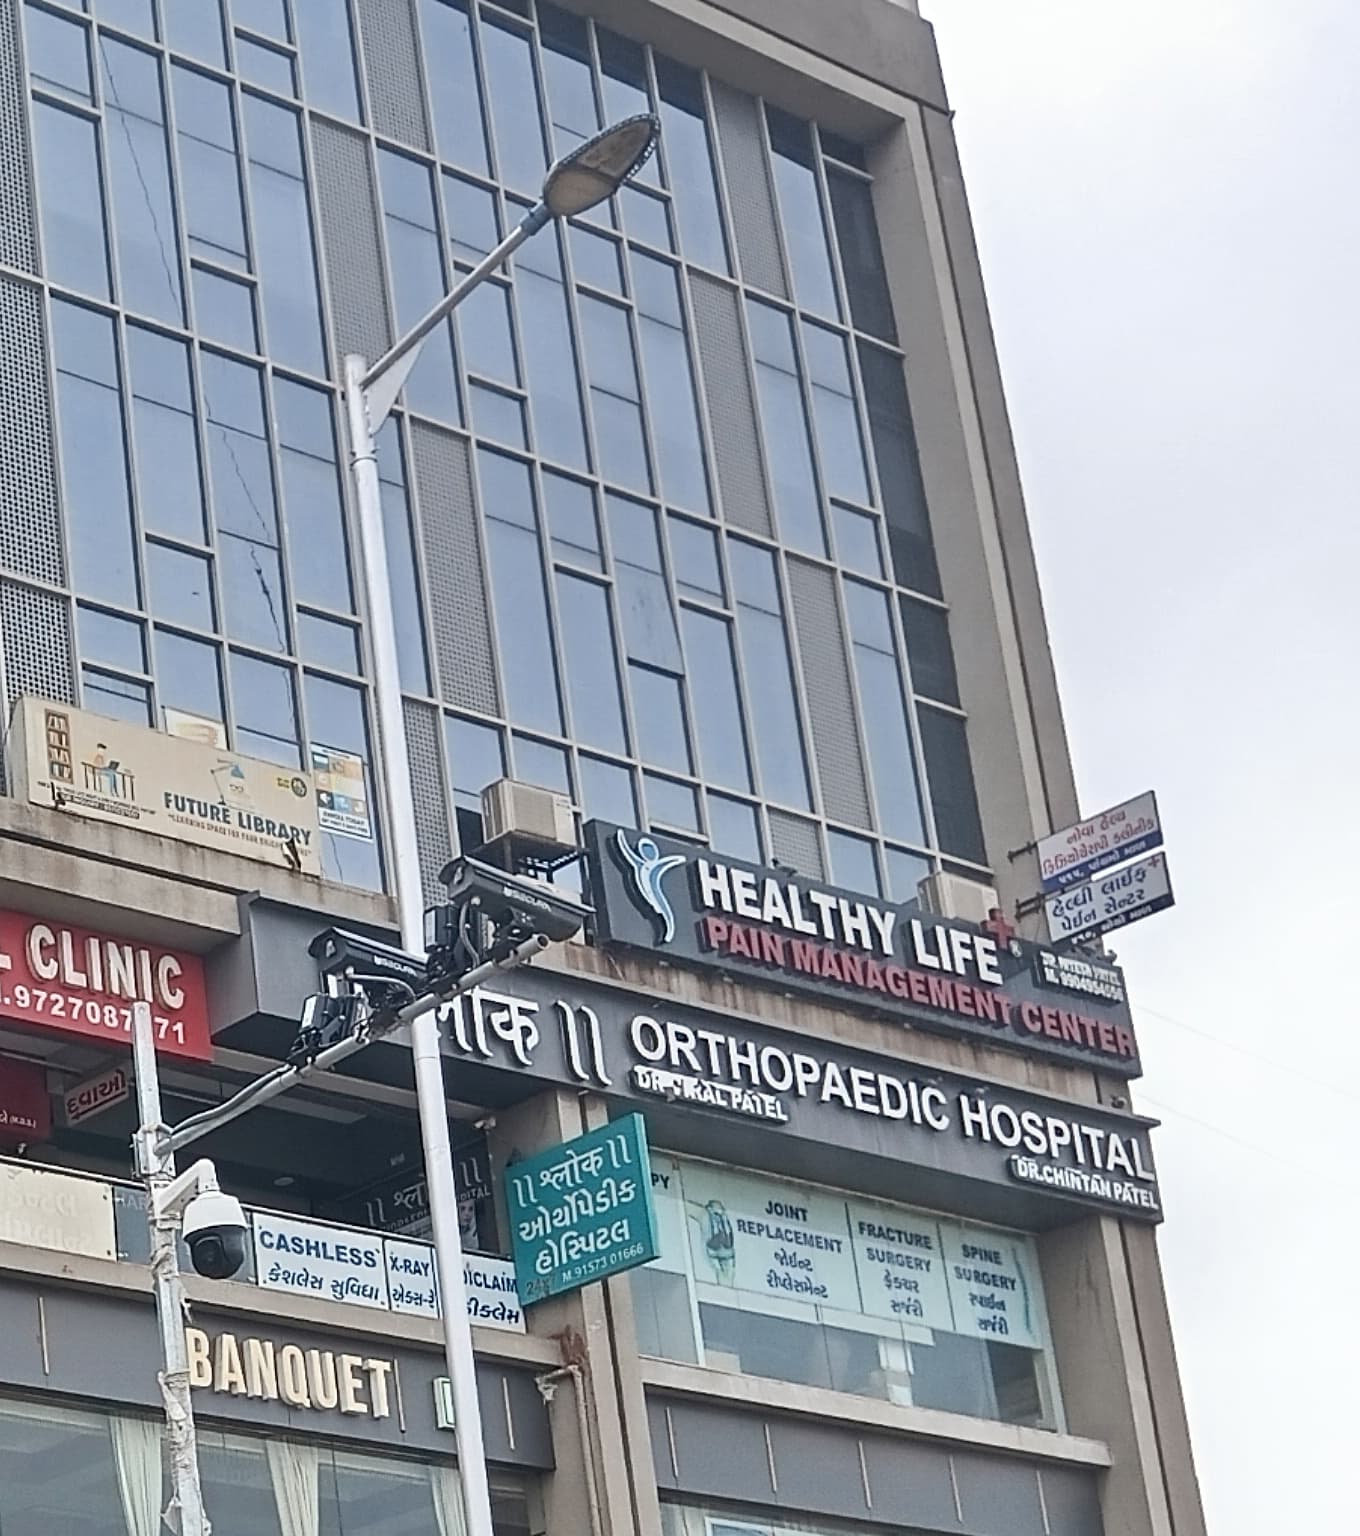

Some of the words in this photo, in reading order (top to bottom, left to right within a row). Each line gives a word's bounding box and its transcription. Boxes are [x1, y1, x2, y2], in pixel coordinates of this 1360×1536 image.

[164, 791, 231, 825] FUTURE
[238, 811, 312, 847] LIBRARY
[698, 860, 897, 956] HEALTHY
[913, 919, 1004, 987] LIFE
[25, 922, 185, 1013] CLINIC
[706, 916, 787, 970] PAIN
[792, 940, 1014, 1027] MANAGEMENT
[1021, 1002, 1137, 1059] CENTER
[630, 1015, 950, 1132] ORTHOPAEDIC
[961, 1095, 1156, 1183] HOSPITAL
[539, 1146, 603, 1190] श्लोक
[765, 1199, 808, 1223] JOINT
[259, 1228, 377, 1270] CASHLESS
[535, 1218, 630, 1275] હોસ્પિટલ
[737, 1218, 843, 1254] REPLACEMENT
[858, 1221, 933, 1250] FRACTURE
[962, 1244, 1002, 1265] SPINE
[390, 1254, 430, 1277] X-RAY
[867, 1248, 931, 1273] SURGERY
[955, 1265, 1016, 1292] SURGERY
[267, 1263, 325, 1299] કેશલેસ
[331, 1276, 380, 1303] સુવિધા
[185, 1327, 392, 1419] BANQUET
